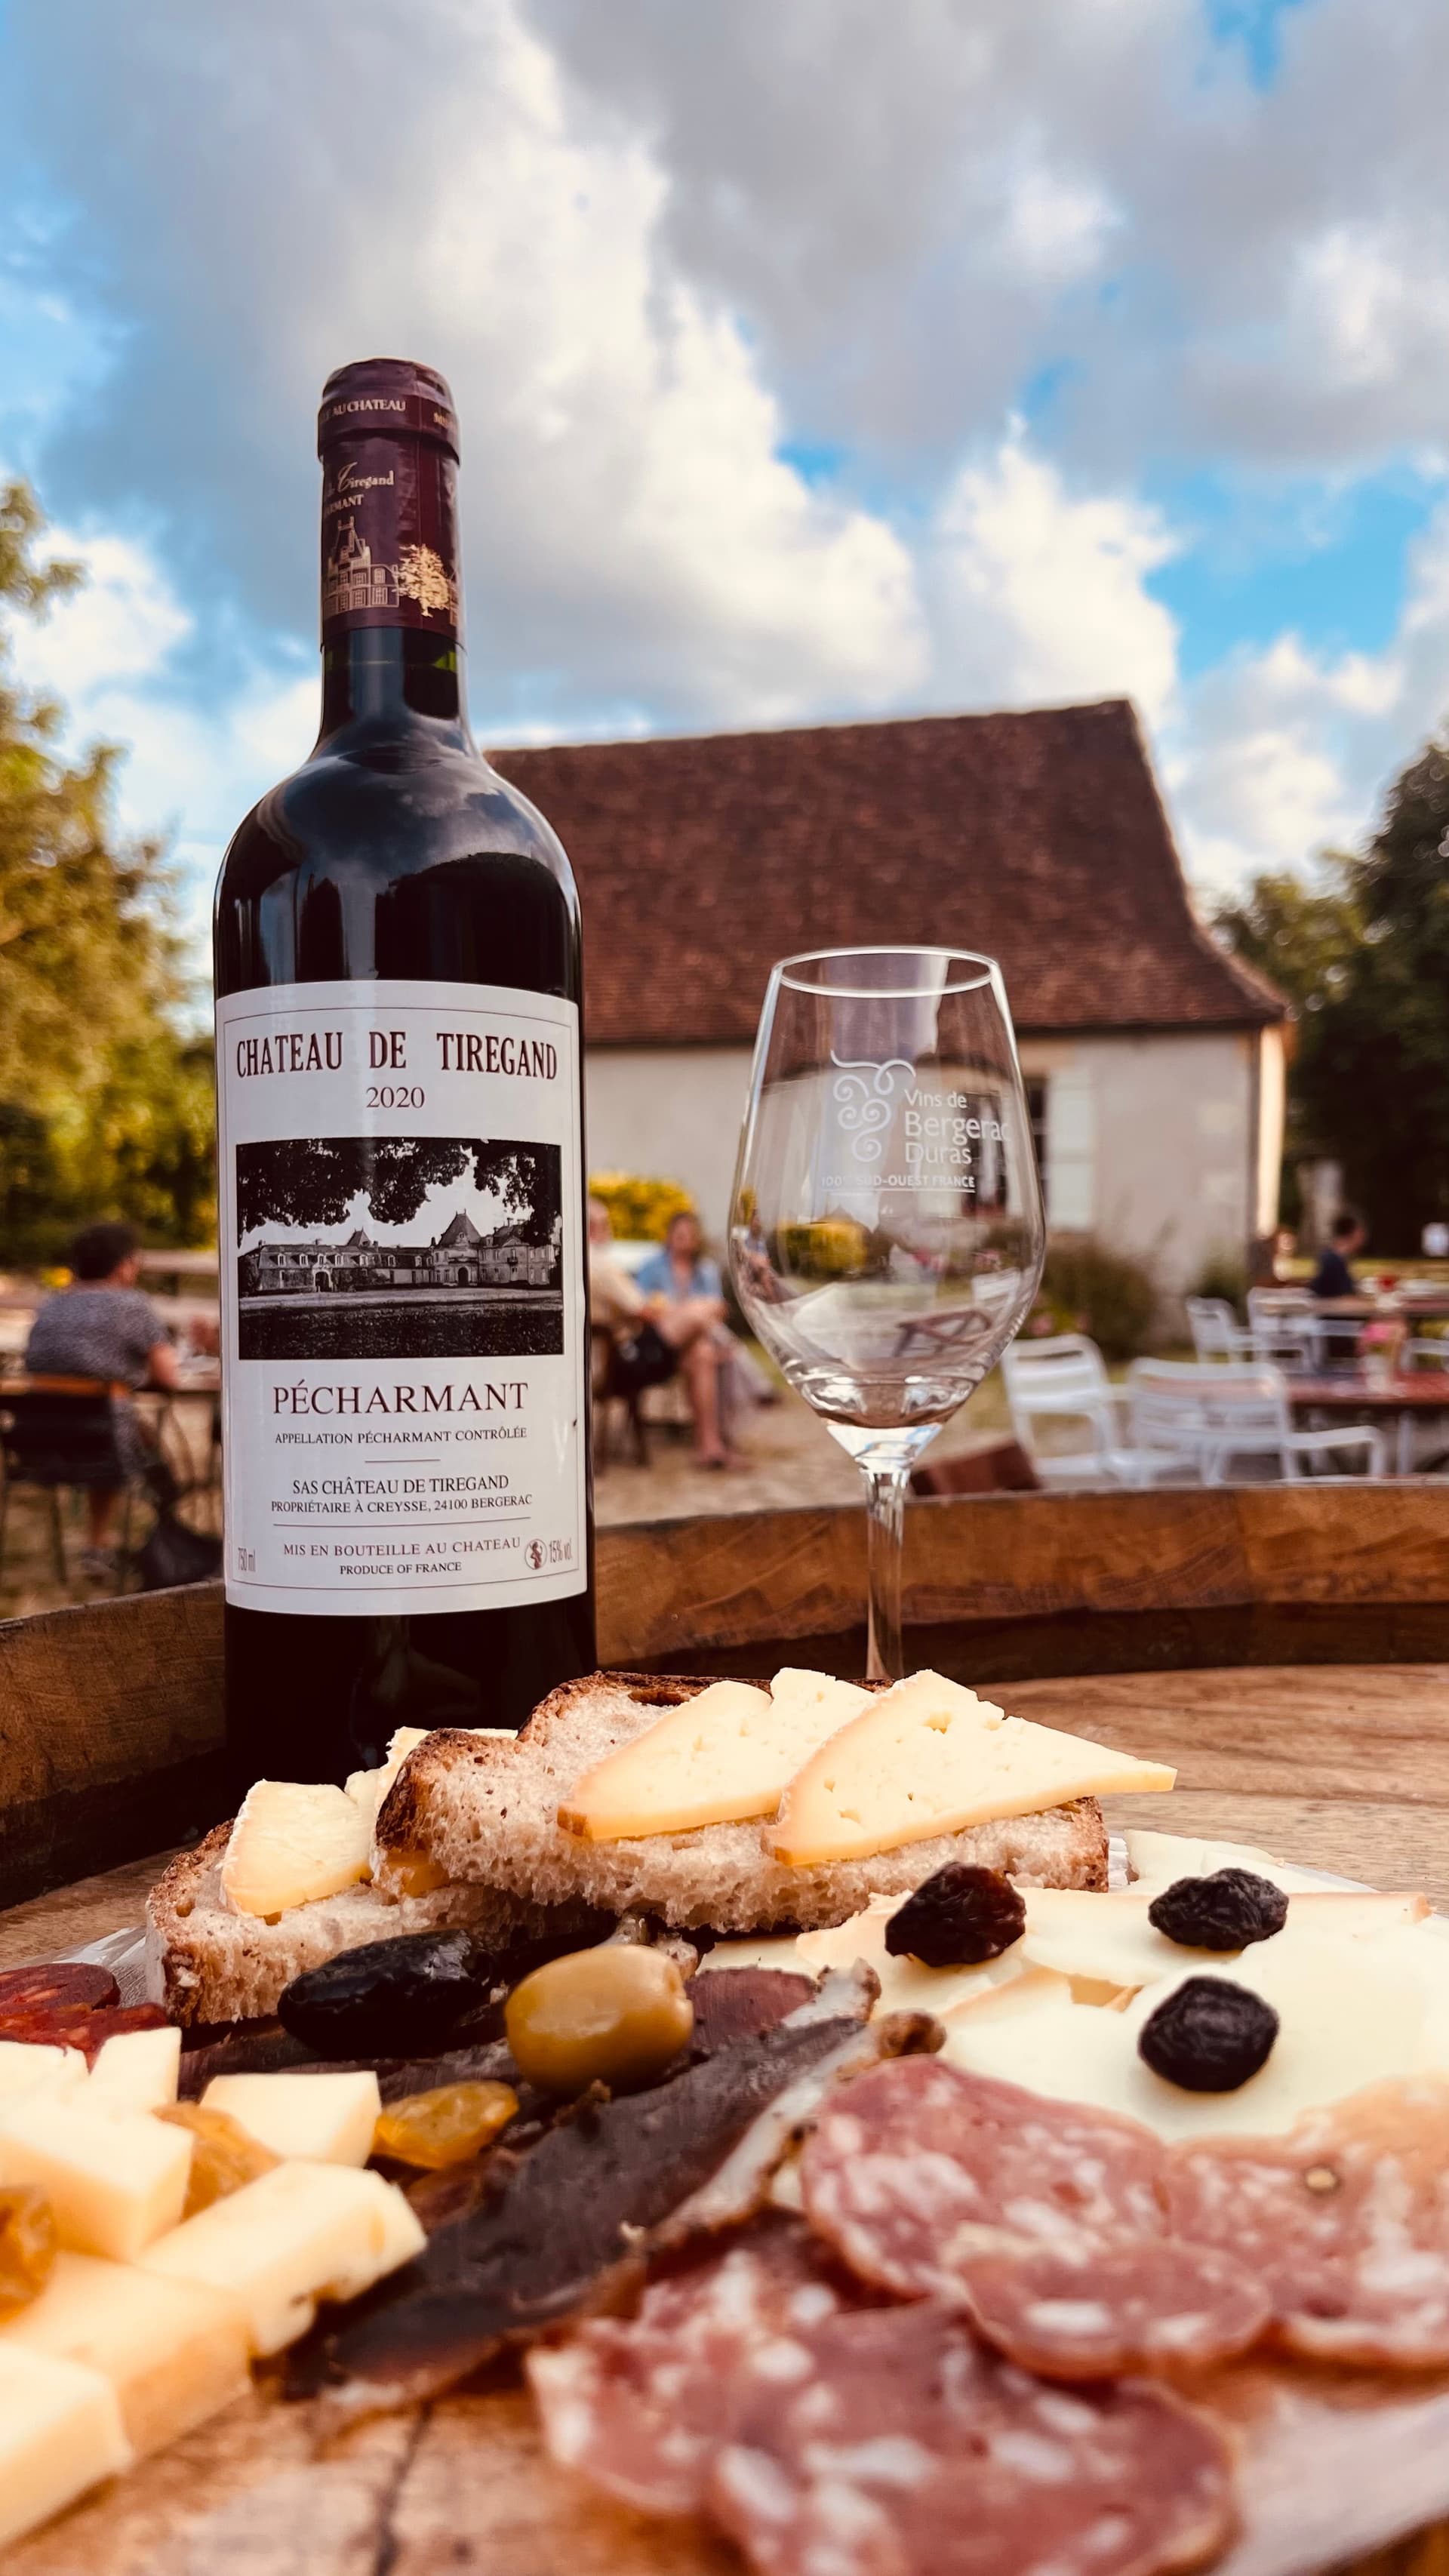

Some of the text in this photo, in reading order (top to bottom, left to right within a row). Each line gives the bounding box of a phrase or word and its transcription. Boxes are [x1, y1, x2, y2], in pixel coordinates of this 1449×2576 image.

[346, 399, 406, 412] CHATEAU
[338, 462, 395, 491] Tiregand
[236, 1031, 557, 1080] CHATEAU DE TIREGAND
[366, 1086, 425, 1109] 2020
[904, 1088, 968, 1109] Vins de
[905, 1110, 1011, 1146] Bergerac
[906, 1142, 972, 1165] Duras
[856, 1174, 929, 1187] SUD-OUEST
[932, 1175, 975, 1188] FRANCE
[272, 1378, 529, 1414] PÉCHARMANT
[275, 1426, 528, 1444] APPELLATION PÉCHARMANT CONTRÔLÉE
[293, 1475, 509, 1494] SAS CHÂTEAU DE TIREGAND
[271, 1494, 533, 1513] PROPRIÉTAIRE À CREYSSE, 24100 BERGERAC
[284, 1537, 521, 1557] MIS EN BOUTEILLE AU CHATEAU
[340, 1562, 462, 1575] PRODUCE OF FRANCE
